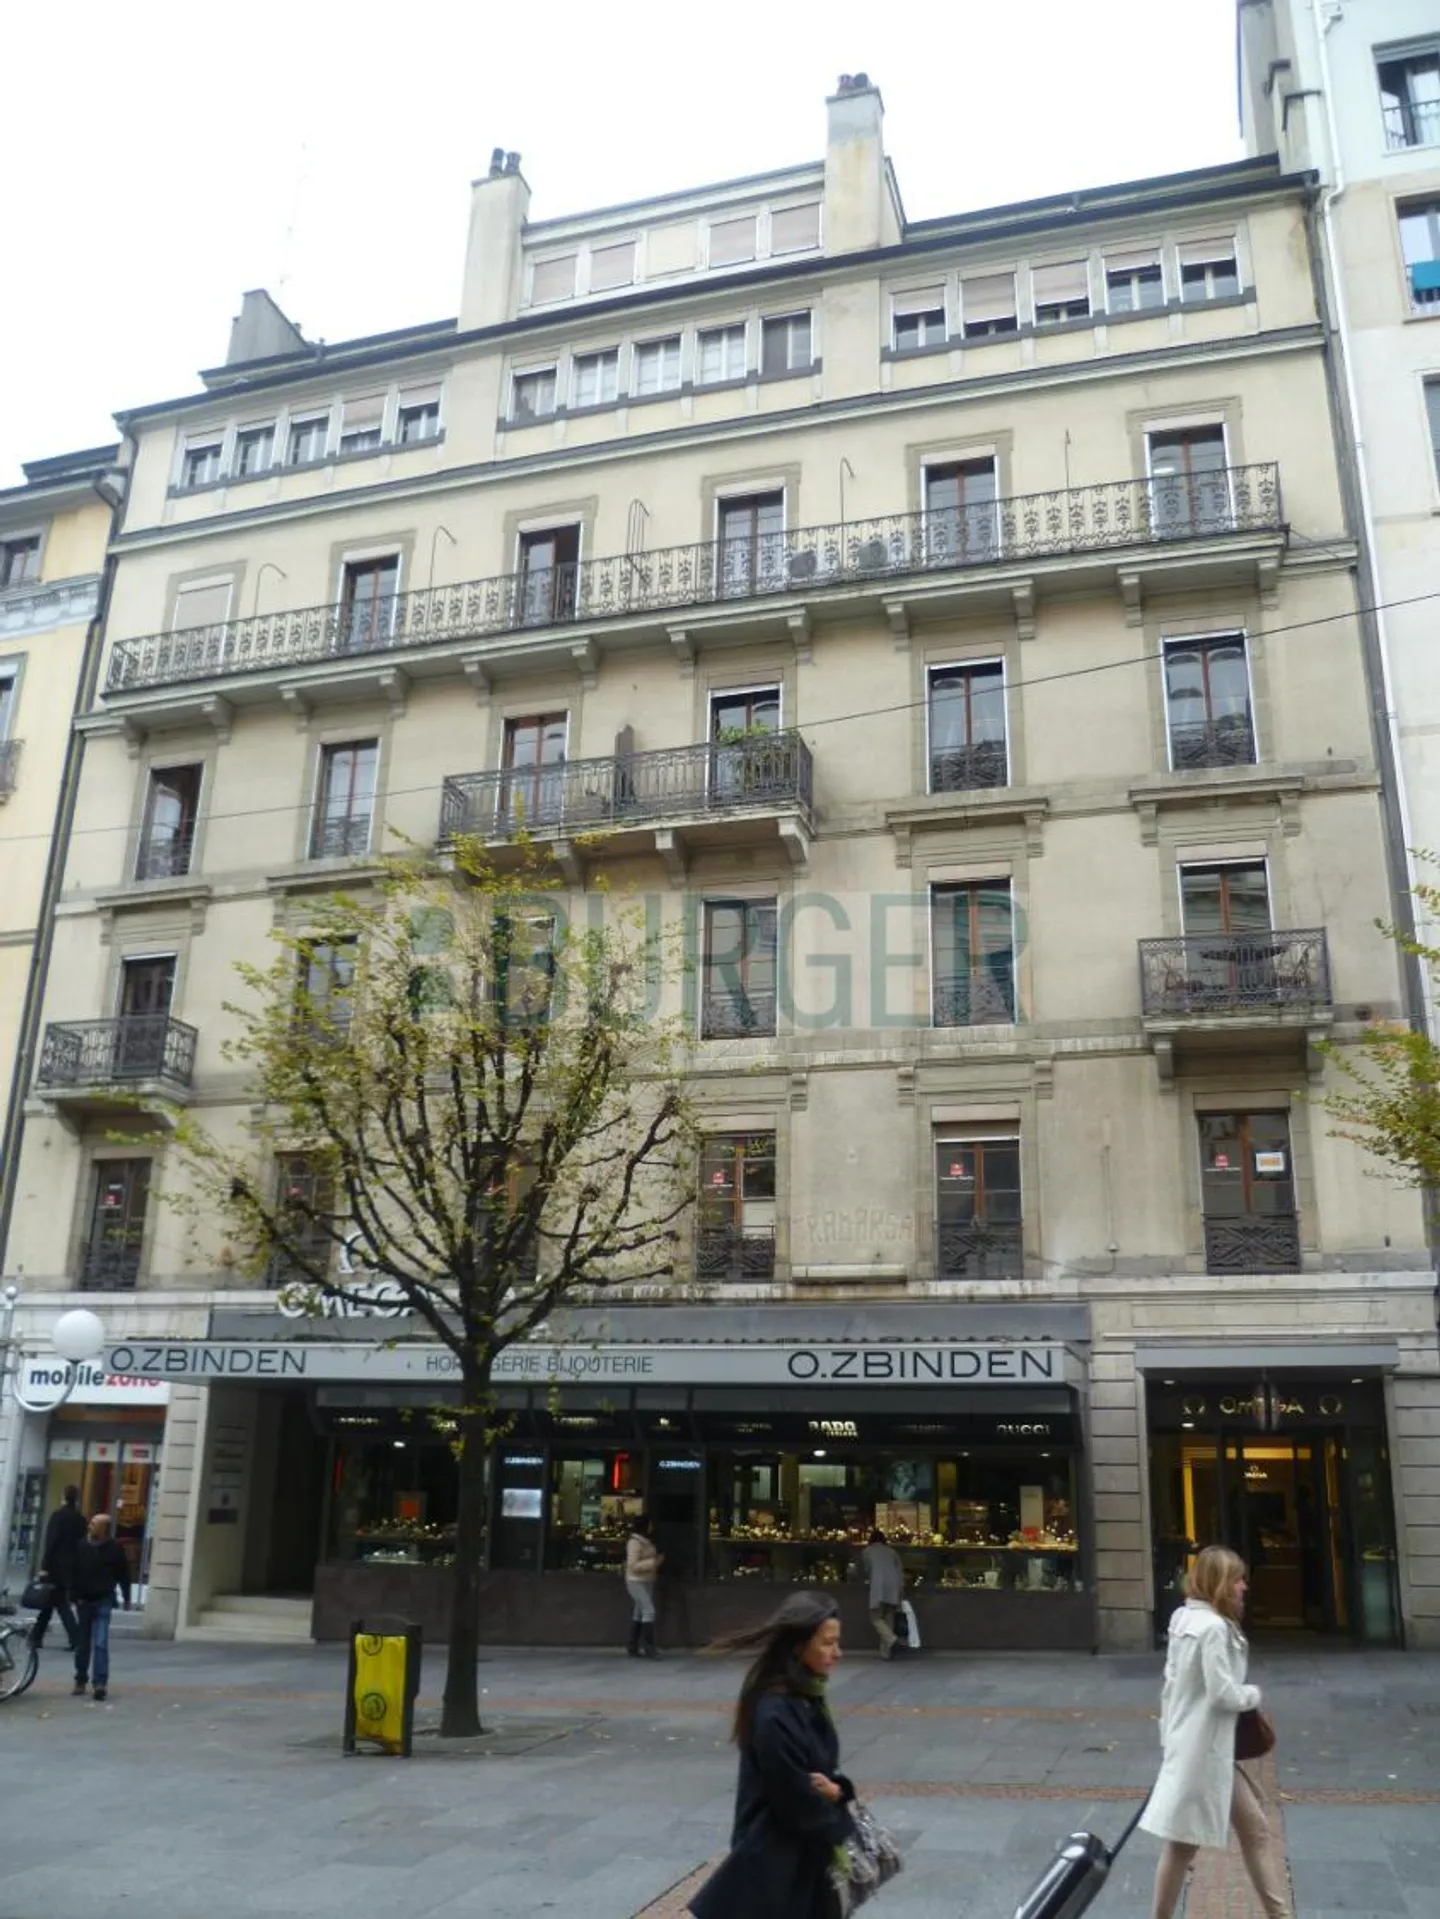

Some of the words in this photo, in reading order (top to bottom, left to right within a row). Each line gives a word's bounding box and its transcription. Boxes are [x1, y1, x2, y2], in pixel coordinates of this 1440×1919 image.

[111, 1348, 305, 1374] O.ZBINDEN
[426, 1356, 540, 1373] HORGERIE
[547, 1356, 653, 1373] BIJOUTERIE
[788, 1349, 1052, 1378] O.ZBINDEN
